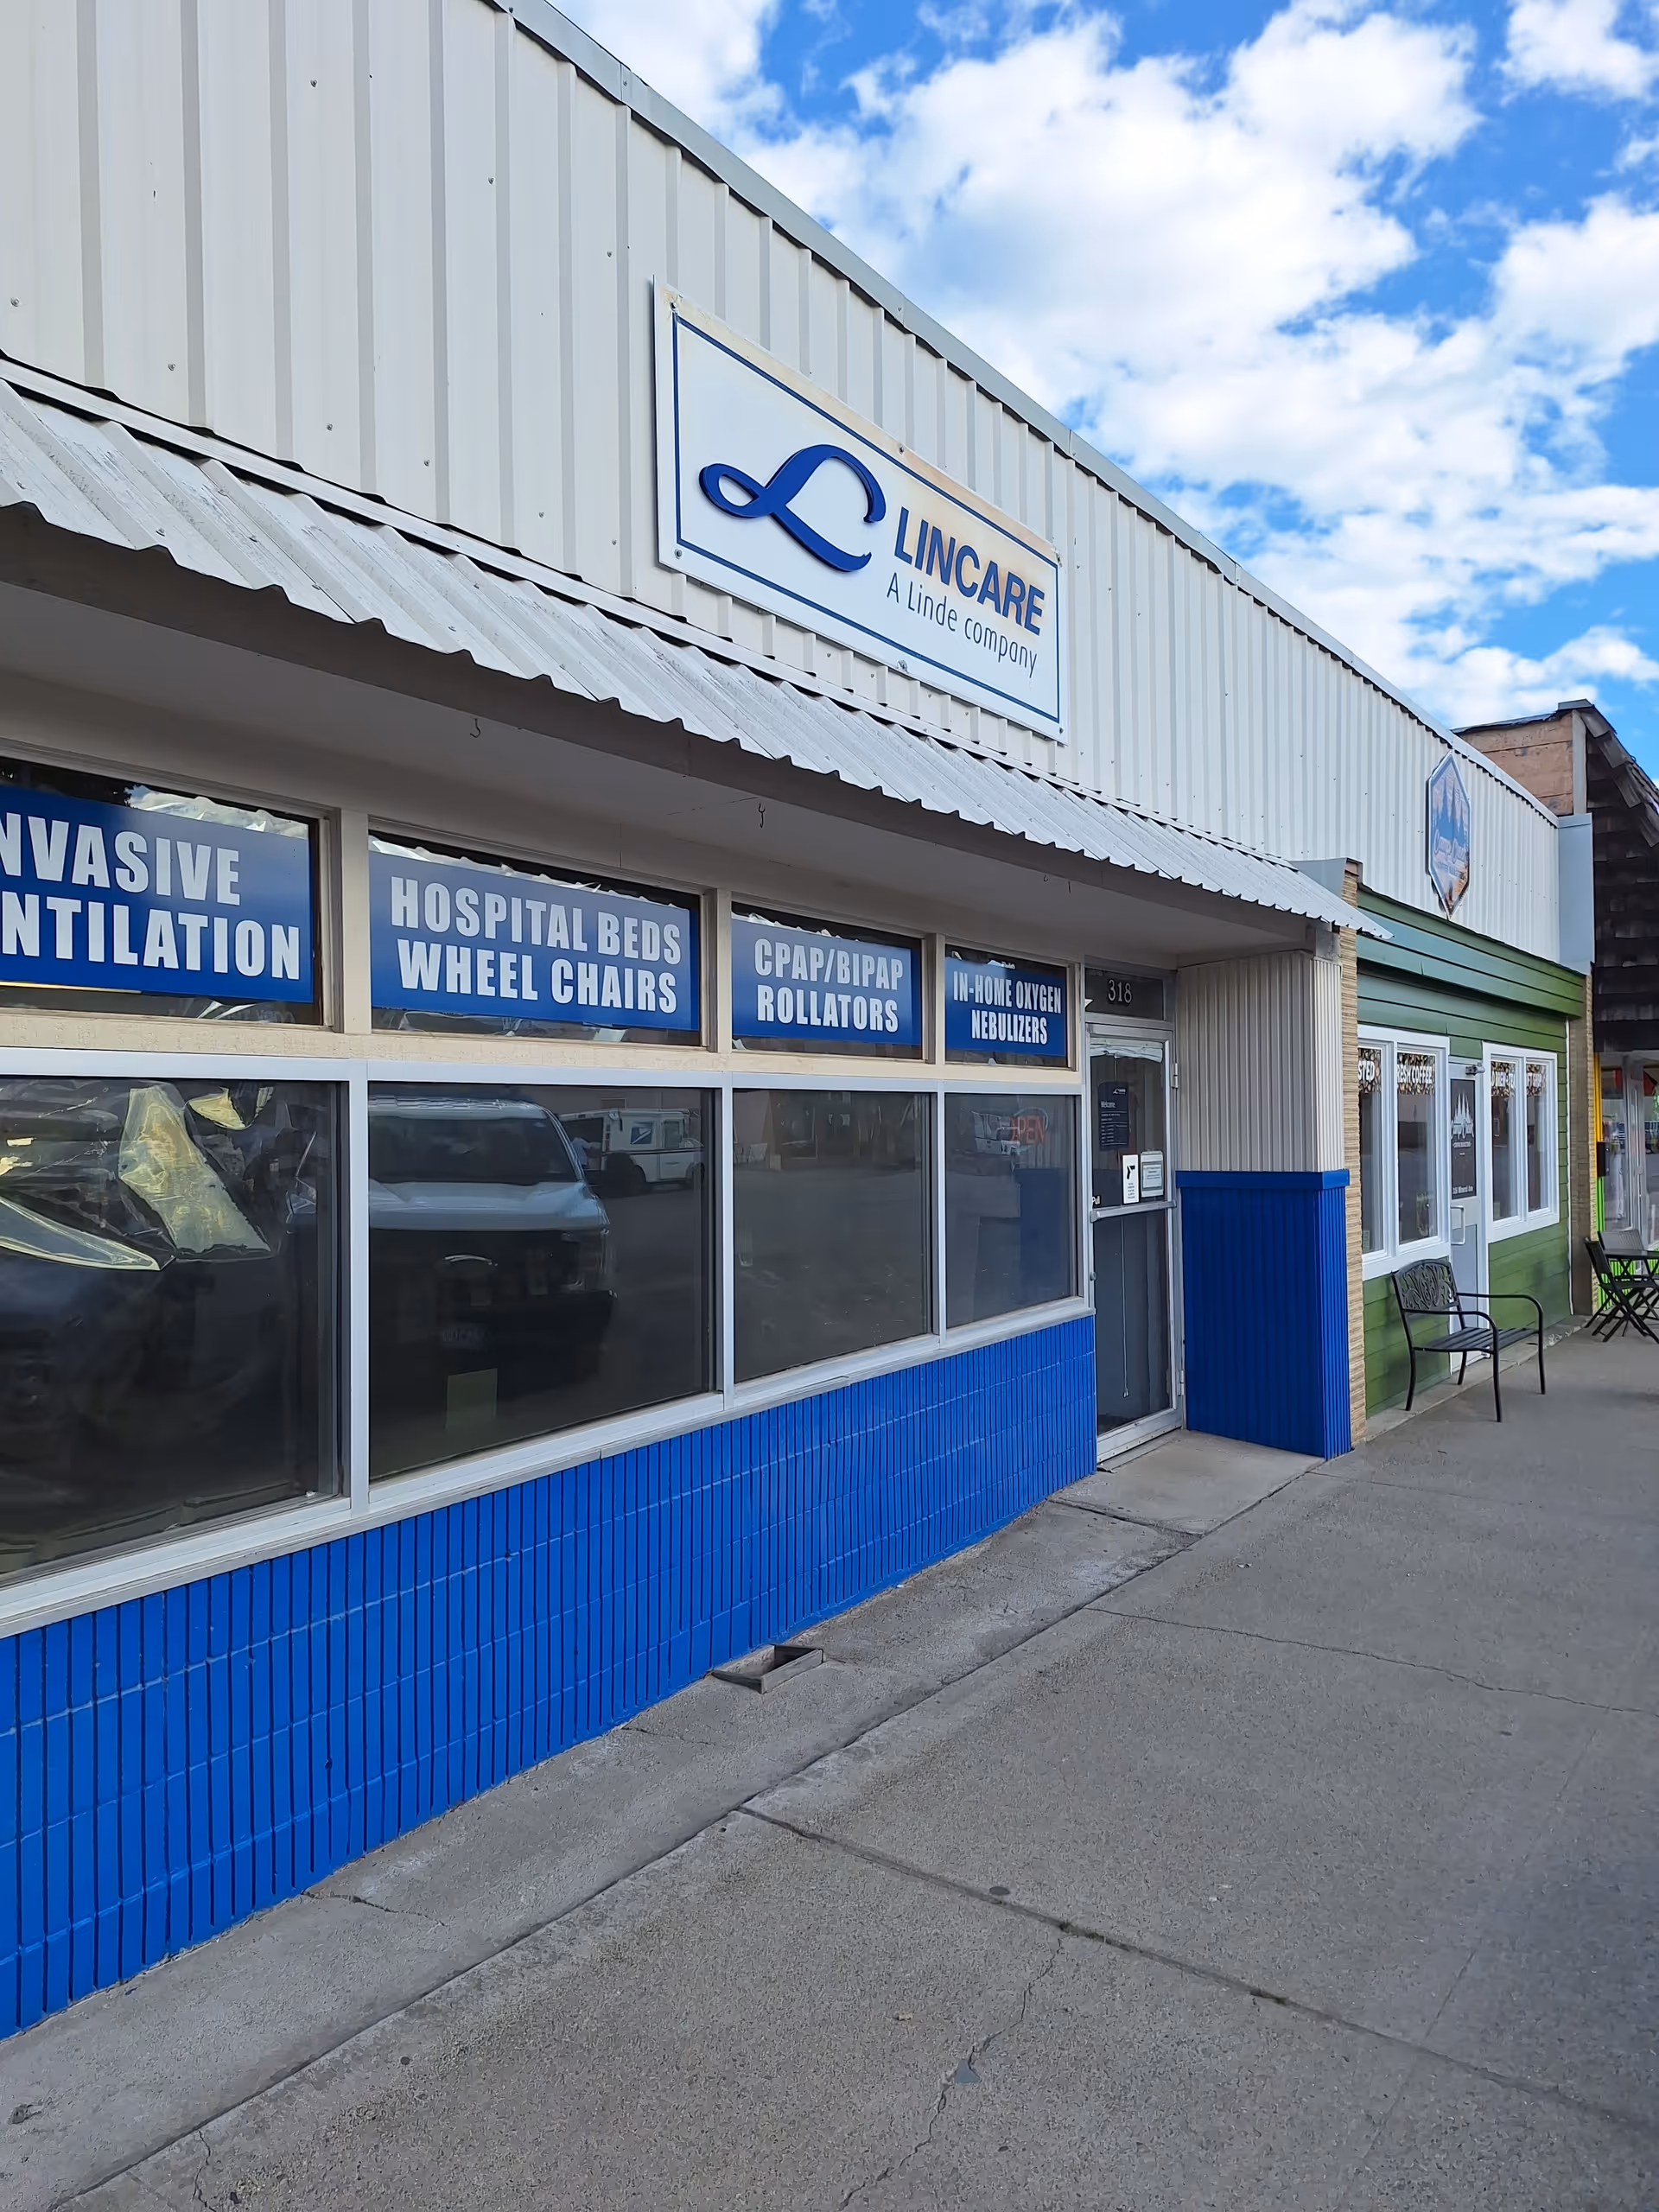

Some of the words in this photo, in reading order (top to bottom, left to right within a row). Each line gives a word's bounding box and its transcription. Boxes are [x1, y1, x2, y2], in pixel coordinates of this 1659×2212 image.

[893, 506, 1046, 636] LINCARE
[887, 572, 899, 603] A
[907, 579, 958, 632] Linde
[964, 617, 1038, 678] company
[2, 891, 300, 980] NTILATION
[390, 875, 588, 952] HOSPITAL
[597, 911, 682, 965] BEDS
[397, 938, 538, 1001] WHEEL
[550, 958, 677, 1014] CHAIRS
[753, 938, 904, 991] CPAP/BIPAP
[952, 970, 1013, 1009] IN-HOME
[1015, 980, 1062, 1014] OXYGEN
[1108, 978, 1133, 1005] 318
[756, 984, 899, 1033] ROLLATORS
[970, 1008, 1048, 1045] NEBULIZERS
